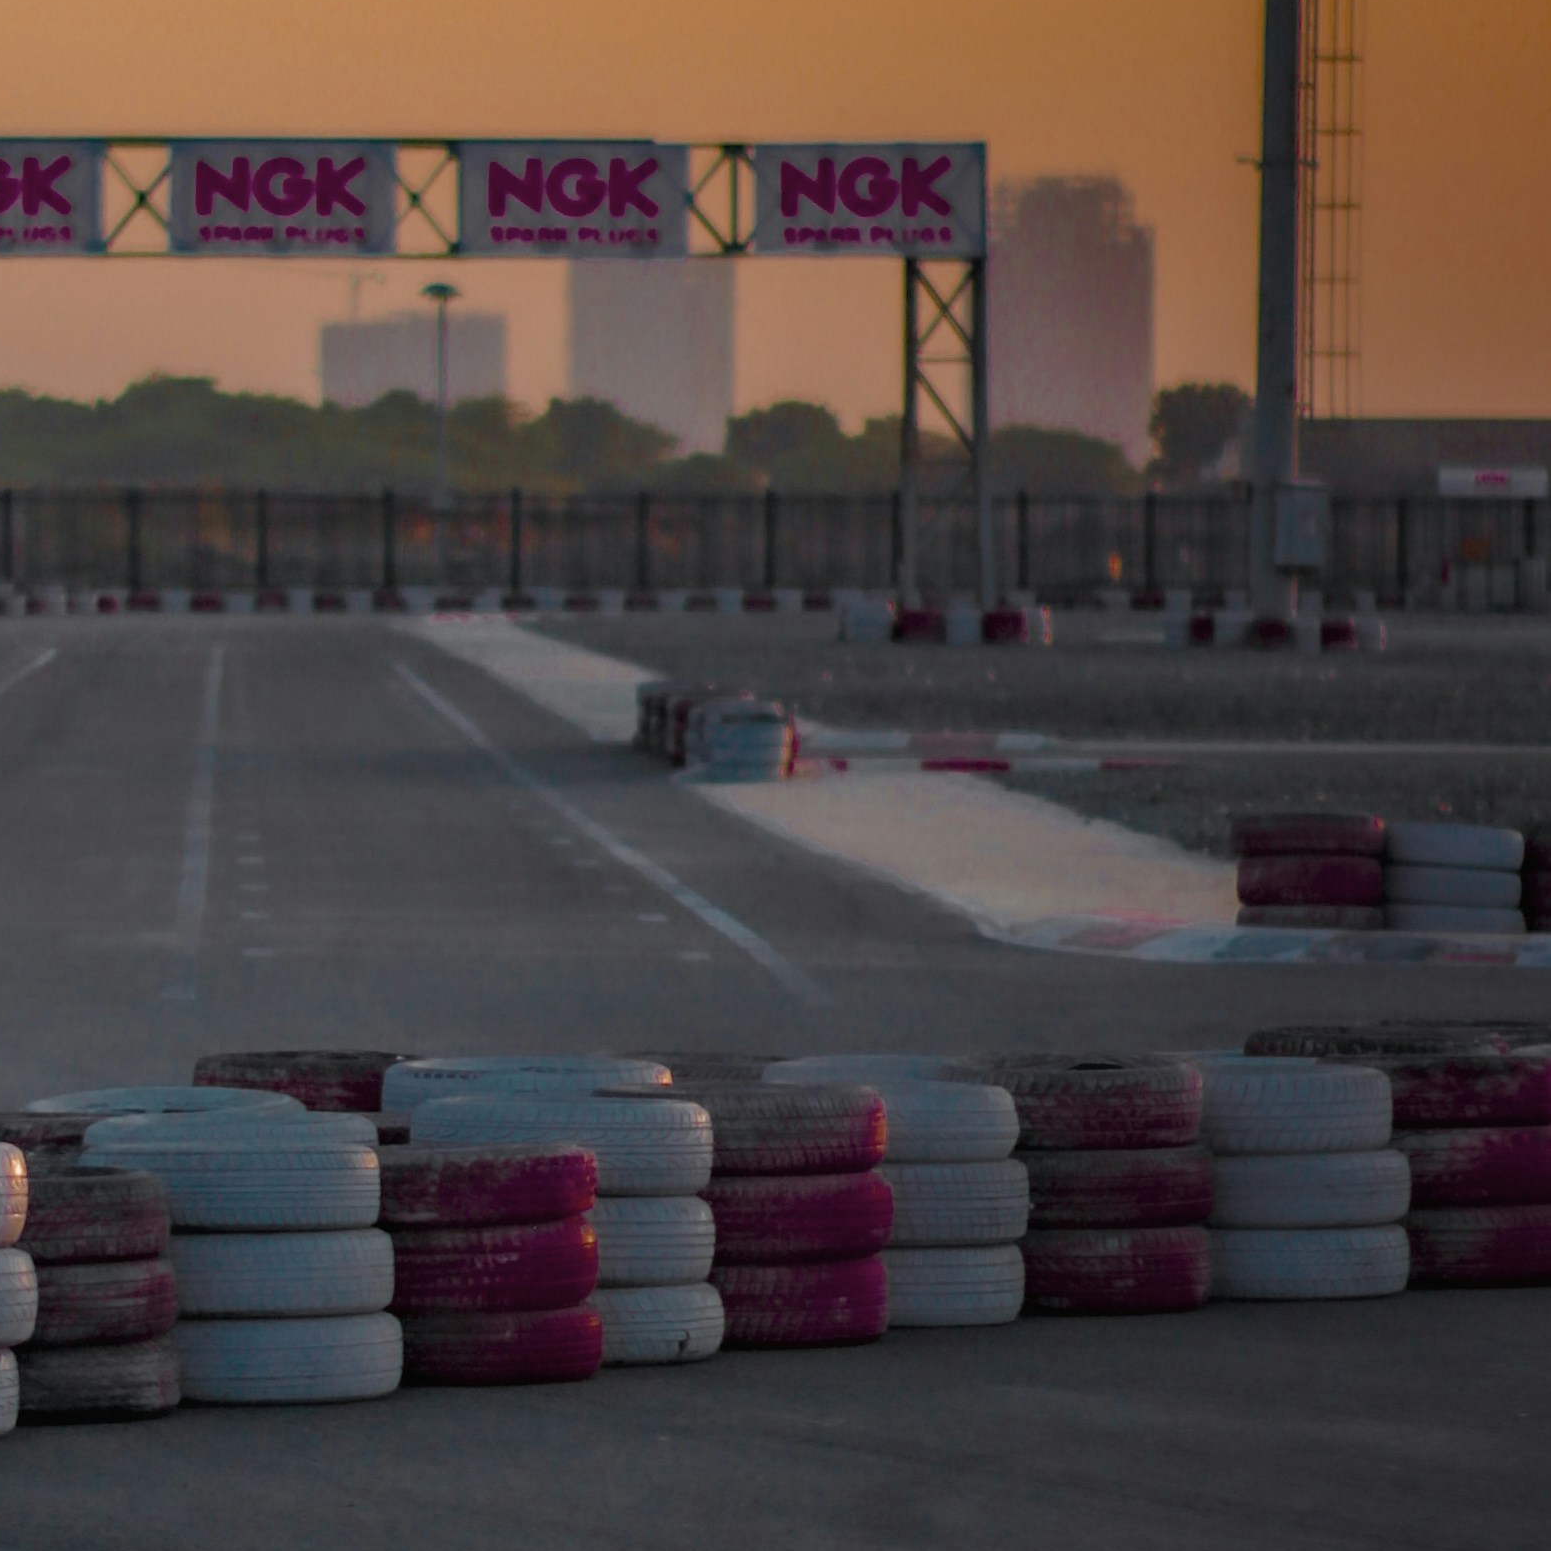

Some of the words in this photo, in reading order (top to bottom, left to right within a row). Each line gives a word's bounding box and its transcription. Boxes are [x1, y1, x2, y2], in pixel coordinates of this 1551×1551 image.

[195, 155, 366, 217] NGK
[487, 156, 659, 218] NGK
[780, 155, 952, 218] NGK
